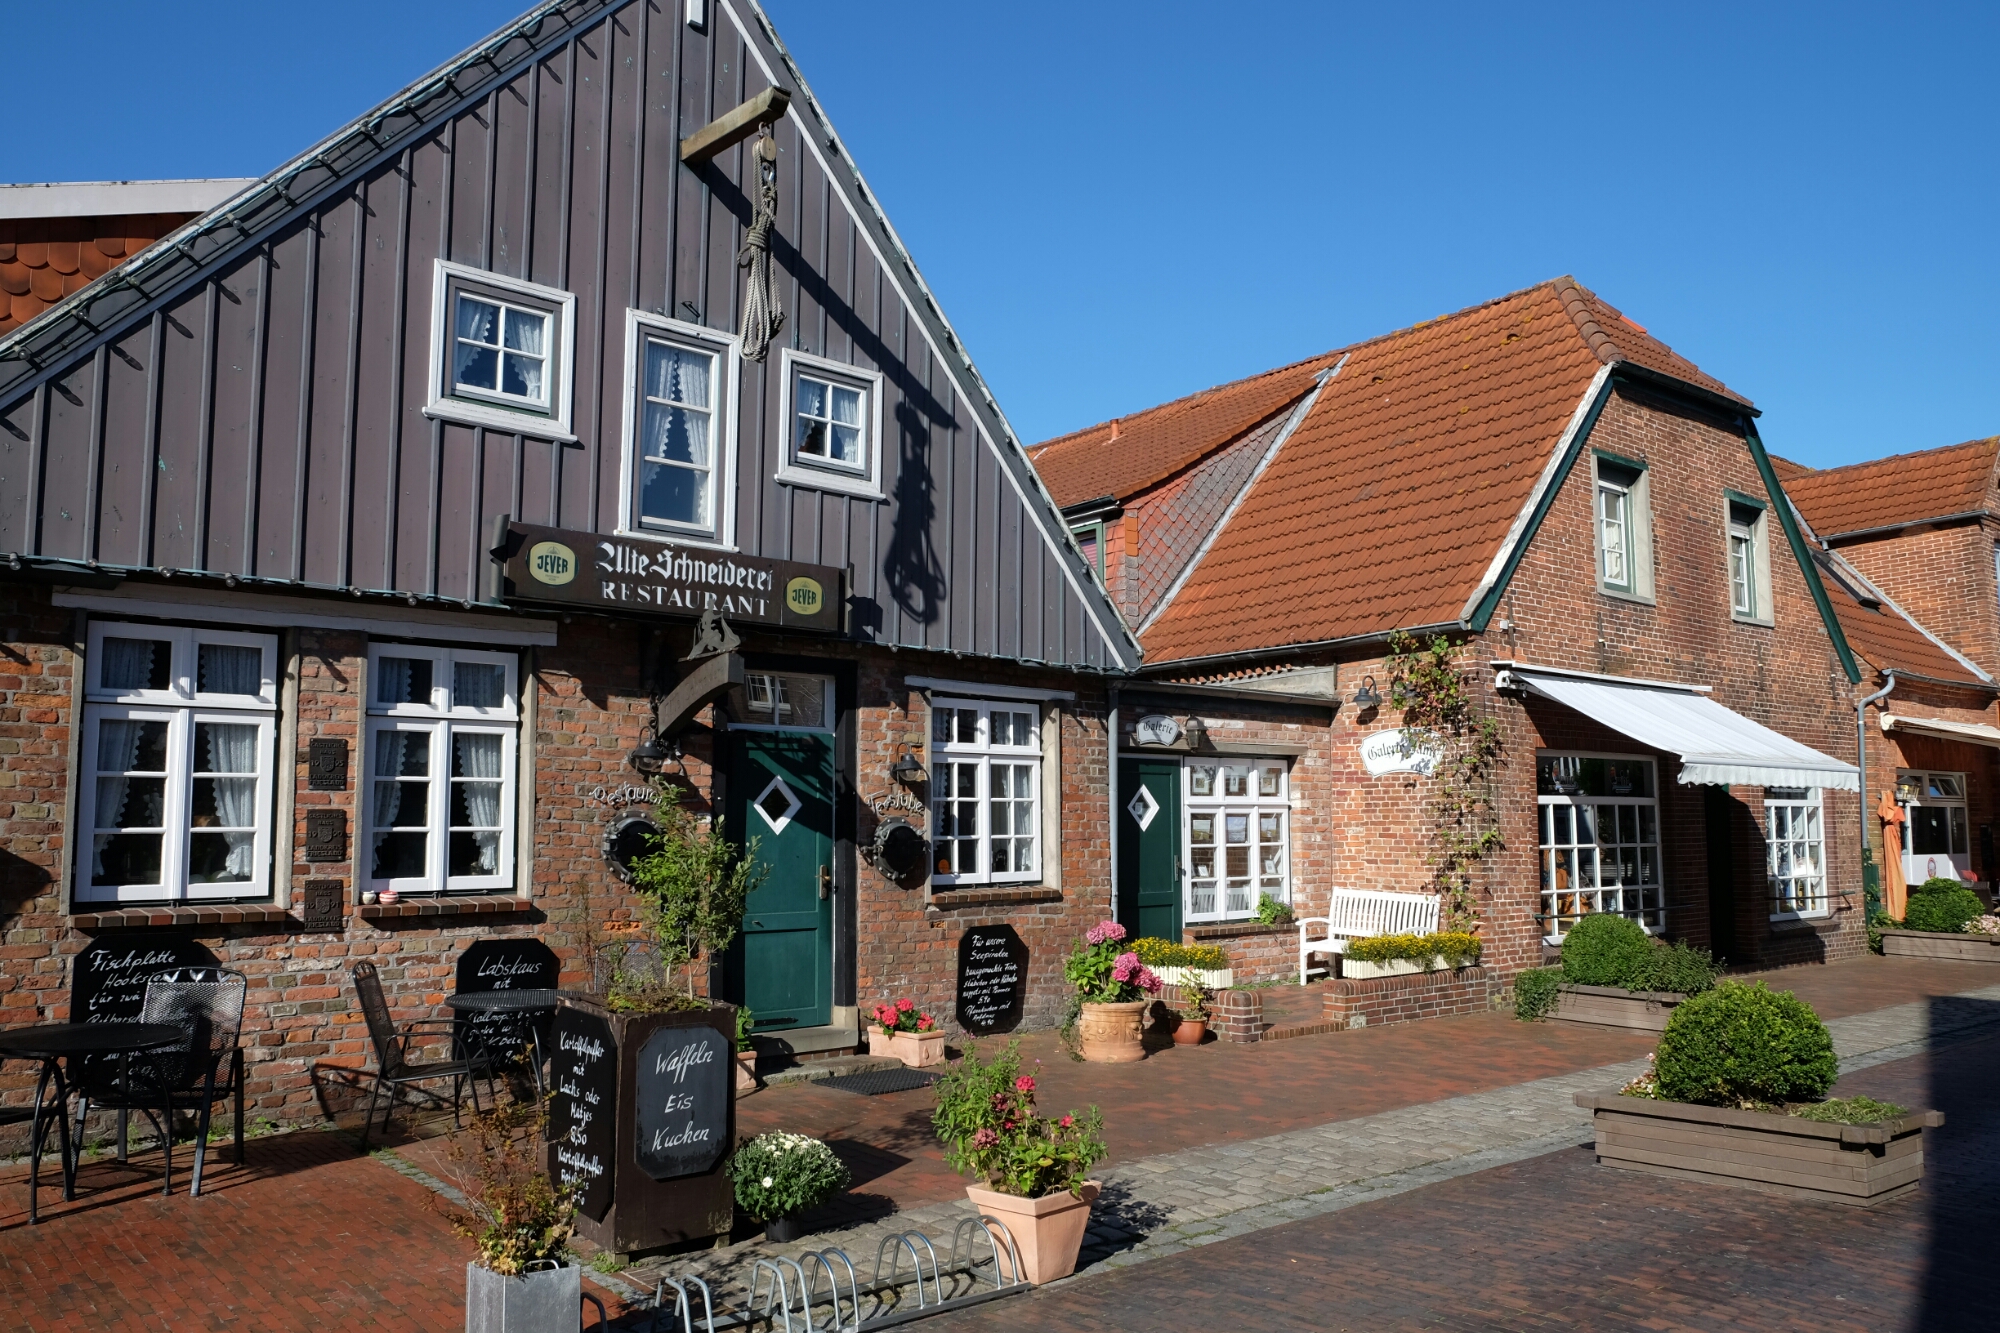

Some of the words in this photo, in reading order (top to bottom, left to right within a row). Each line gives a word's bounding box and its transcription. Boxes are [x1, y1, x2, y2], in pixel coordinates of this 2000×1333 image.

[537, 555, 568, 574] JEVER
[594, 541, 650, 577] Alte
[650, 549, 774, 591] Schneiderei
[601, 581, 770, 616] RESTAURANT
[792, 588, 816, 605] JEVER
[1143, 720, 1173, 734] Galerie
[1368, 741, 1405, 761] Galeri
[90, 950, 176, 975] Fischplatte
[477, 955, 542, 976] Labskaus
[493, 977, 511, 989] mit
[560, 1030, 604, 1065] Kartoffelpuffer
[573, 1062, 584, 1076] mit
[655, 1041, 713, 1084] Waffeln
[561, 1074, 580, 1097] Lachs
[585, 1087, 600, 1105] oder
[571, 1101, 592, 1126] Matjes
[664, 1093, 693, 1113] Eis
[652, 1120, 710, 1152] Kuchen
[558, 1145, 604, 1178] Kartoffelpuffer
